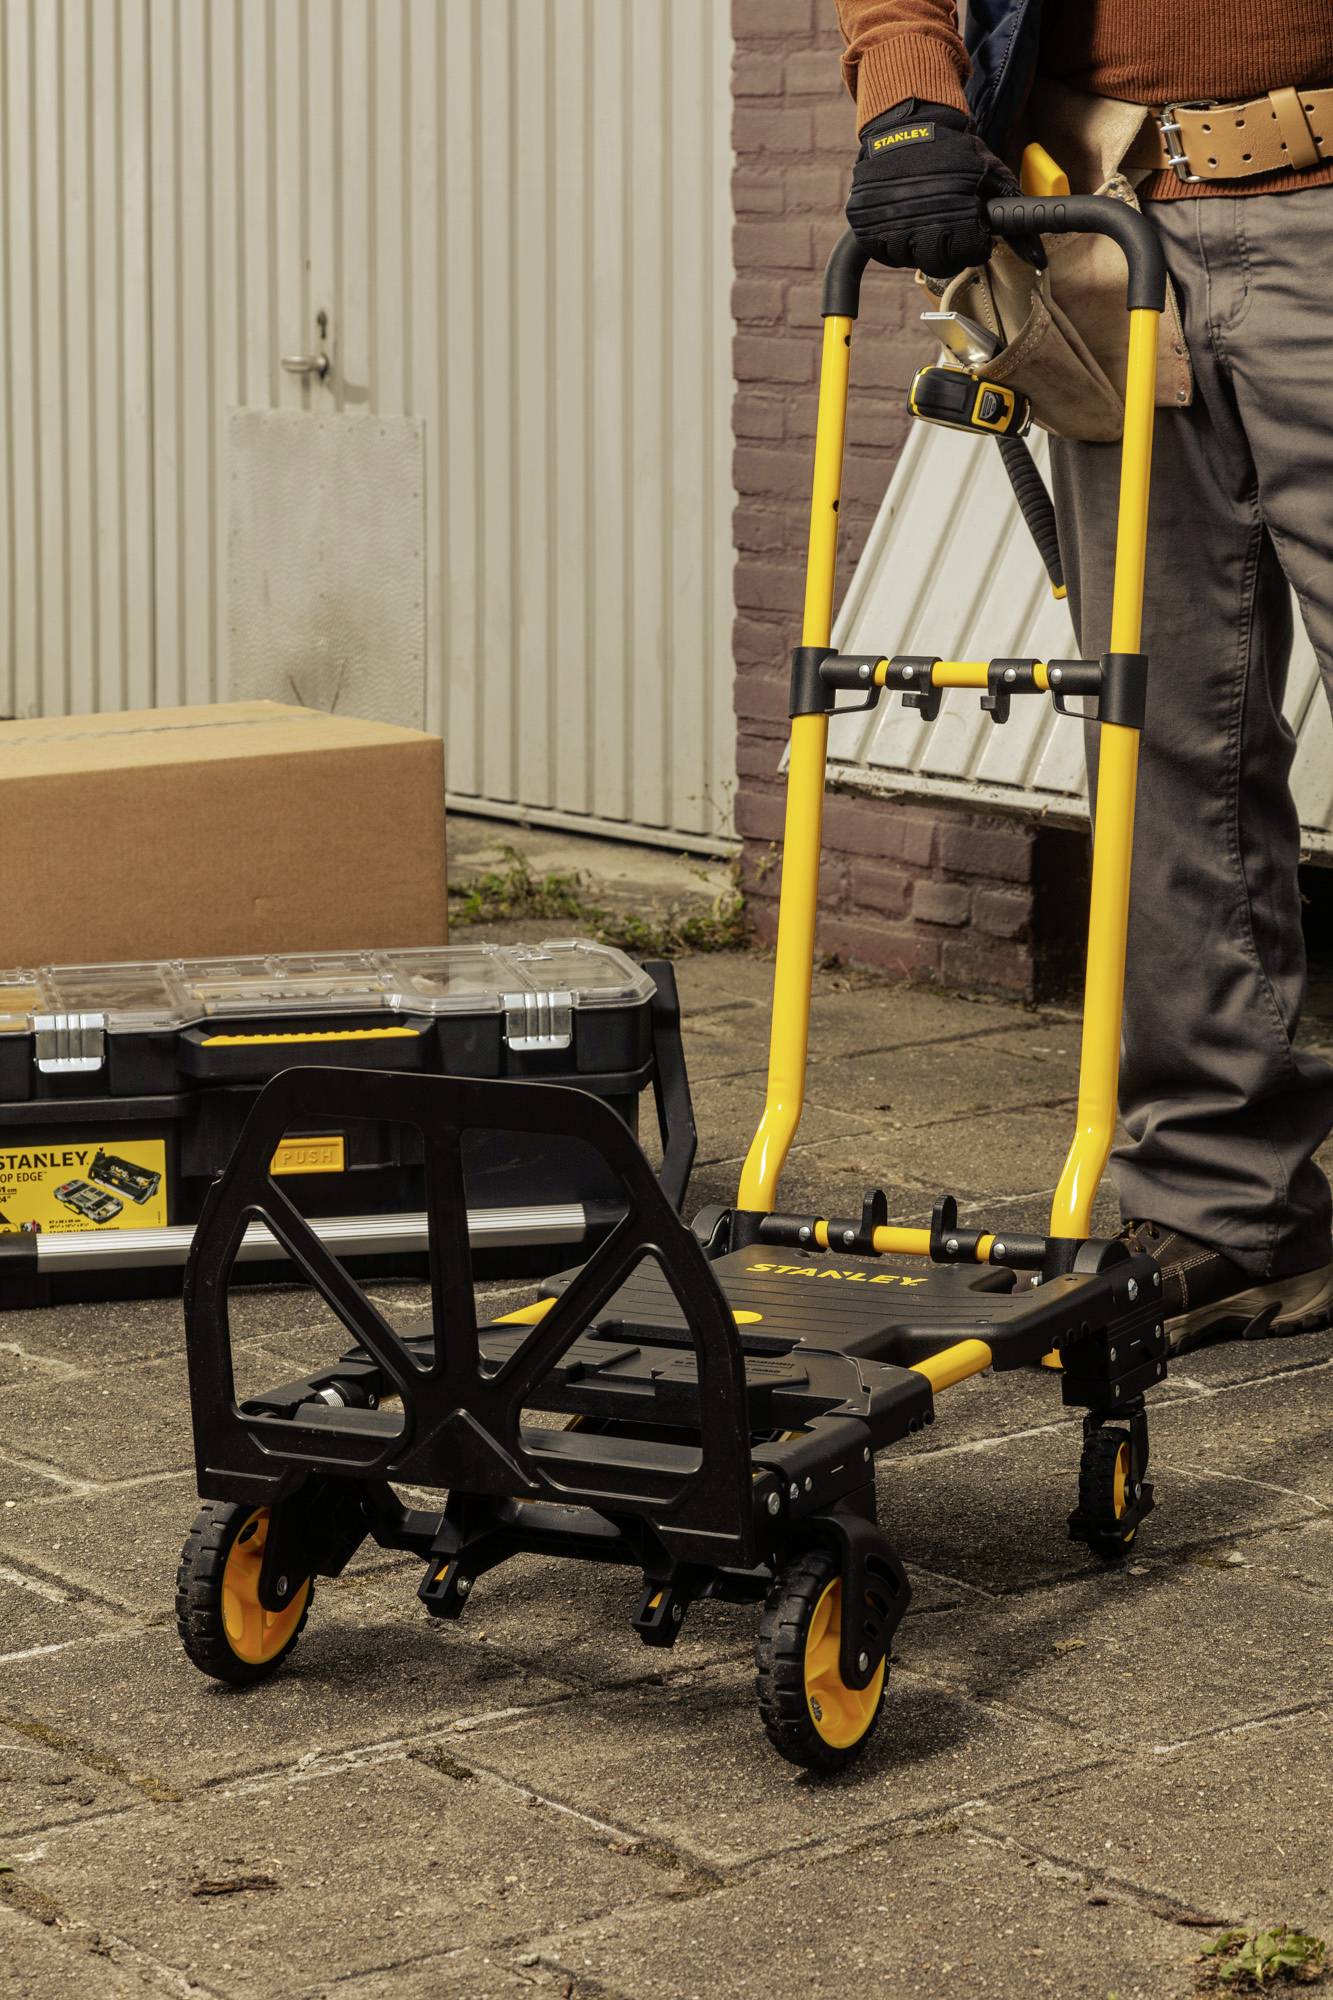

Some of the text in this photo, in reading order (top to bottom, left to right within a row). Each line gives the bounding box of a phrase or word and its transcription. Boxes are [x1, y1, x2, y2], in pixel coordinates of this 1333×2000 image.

[873, 127, 929, 151] STANLEY
[281, 1148, 334, 1165] PUSH
[0, 1173, 13, 1183] OP
[745, 1263, 928, 1287] STANLEY
